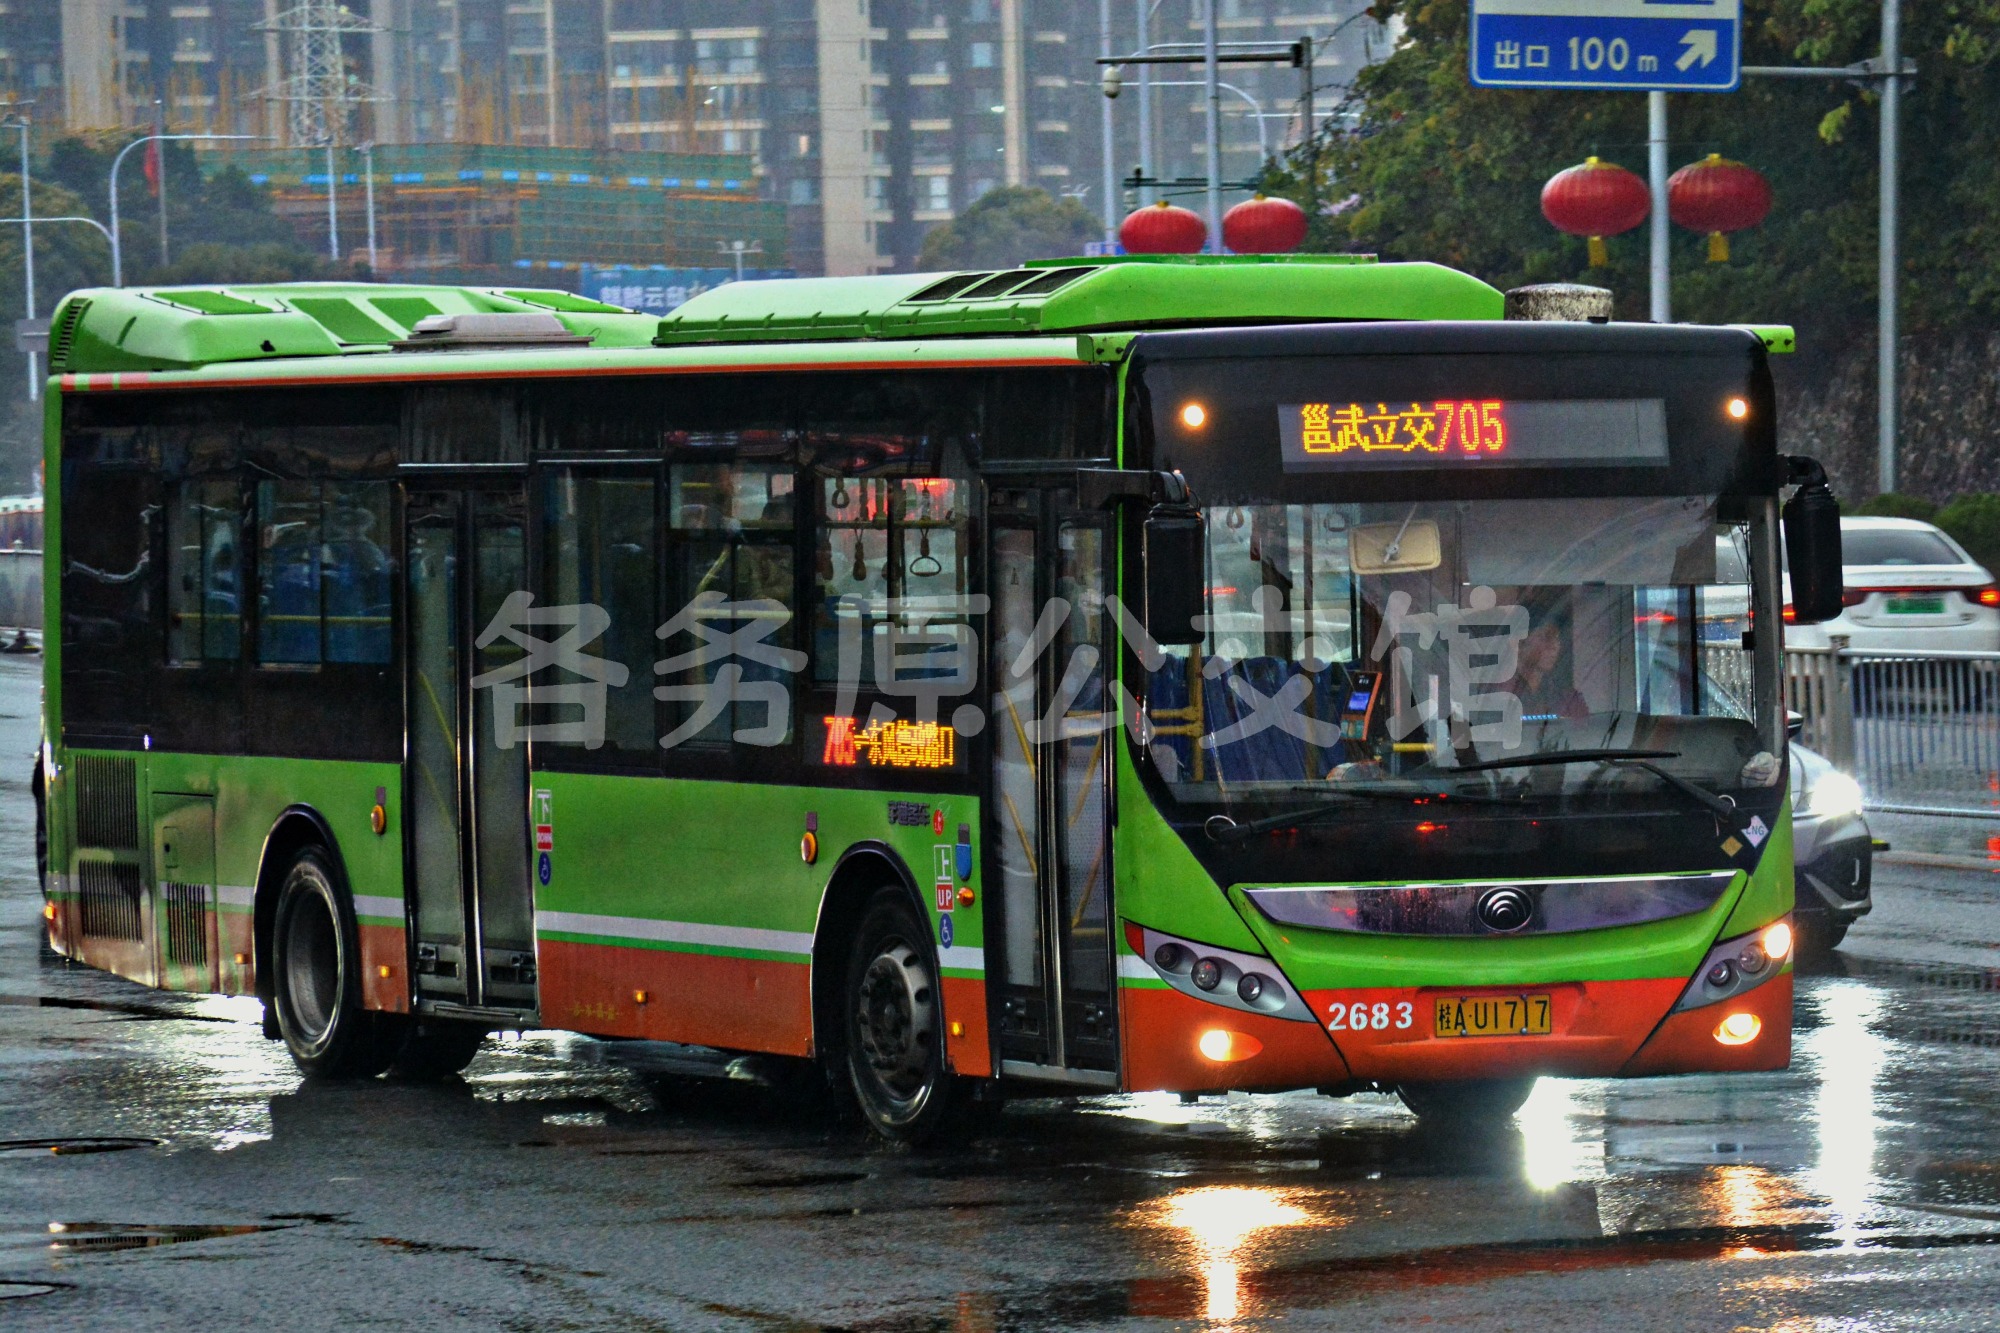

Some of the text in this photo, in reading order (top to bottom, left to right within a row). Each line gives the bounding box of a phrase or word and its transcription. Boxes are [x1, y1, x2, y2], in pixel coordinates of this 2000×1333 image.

[1494, 40, 1549, 69] 出口
[1567, 37, 1629, 71] 100
[938, 889, 952, 907] UP
[1328, 1001, 1413, 1031] 2683
